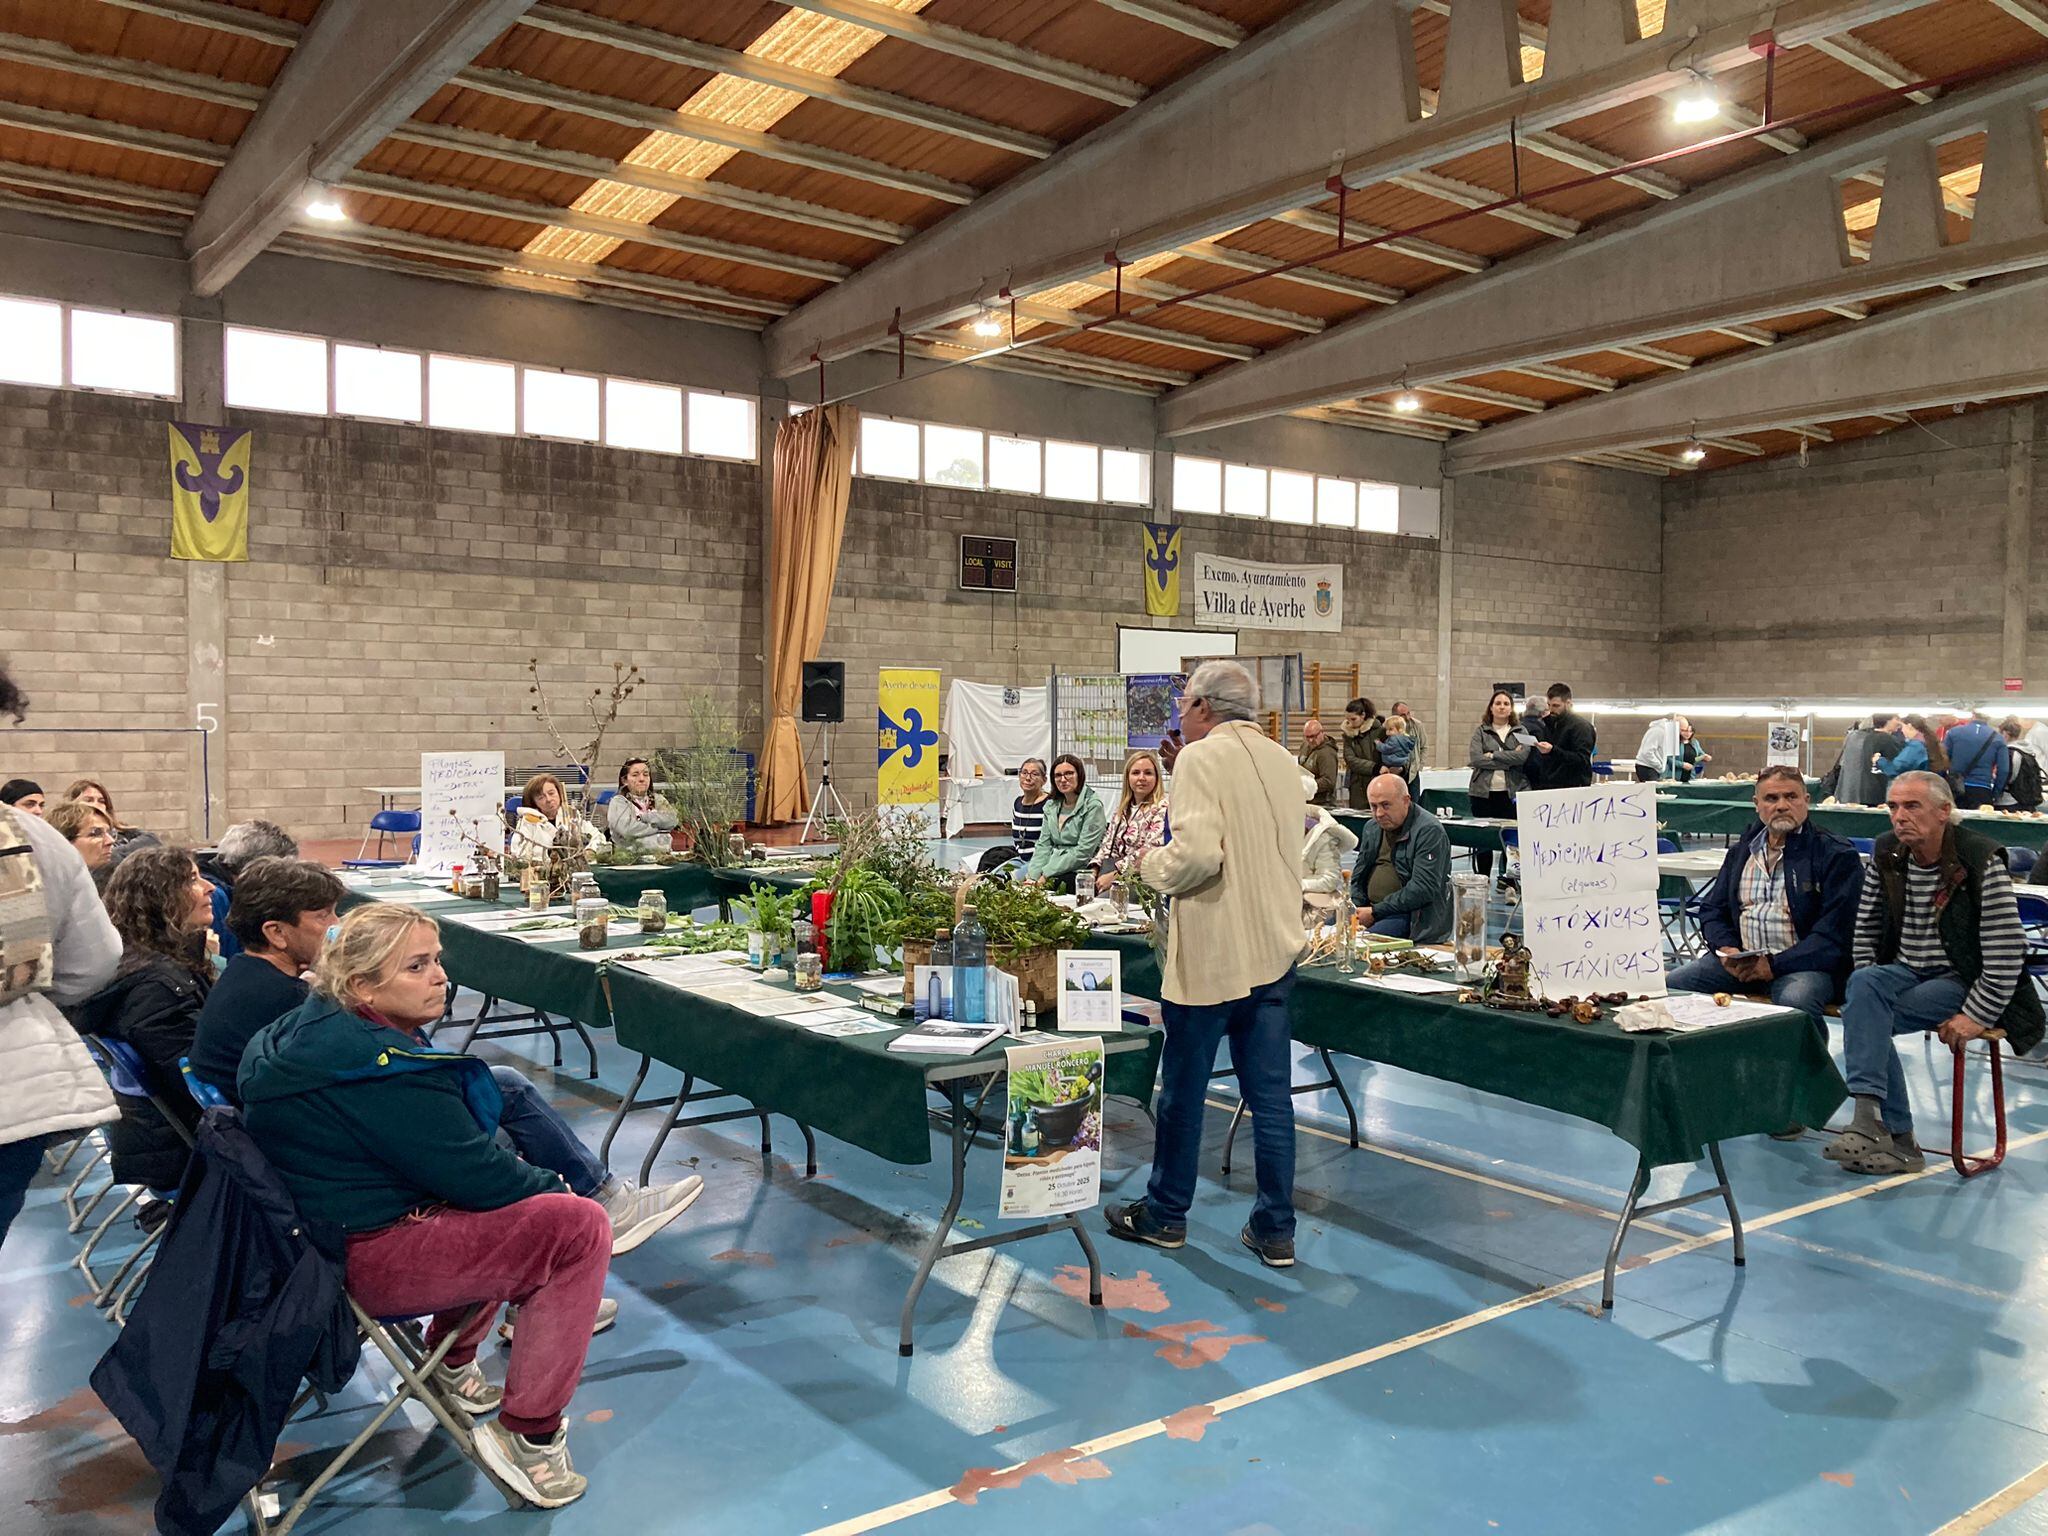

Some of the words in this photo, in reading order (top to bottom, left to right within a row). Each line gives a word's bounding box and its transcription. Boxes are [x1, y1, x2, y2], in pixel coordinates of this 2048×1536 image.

[965, 557, 984, 567] LOCAL
[1203, 565, 1240, 583] Excmo.
[1241, 569, 1306, 588] Ayuntamiento
[1203, 590, 1236, 614] Villa
[1240, 594, 1256, 615] de
[1260, 596, 1306, 623] Ayerbe
[197, 703, 218, 734] 5
[1533, 789, 1647, 828] PLANTAS
[1043, 1048, 1071, 1058] CHARLA
[1025, 1062, 1055, 1072] MANUEL
[1056, 1057, 1089, 1068] RONCERO
[1048, 1183, 1056, 1191] 25
[1076, 1176, 1090, 1186] 2025
[458, 1377, 481, 1398] N
[526, 1461, 555, 1485] N
